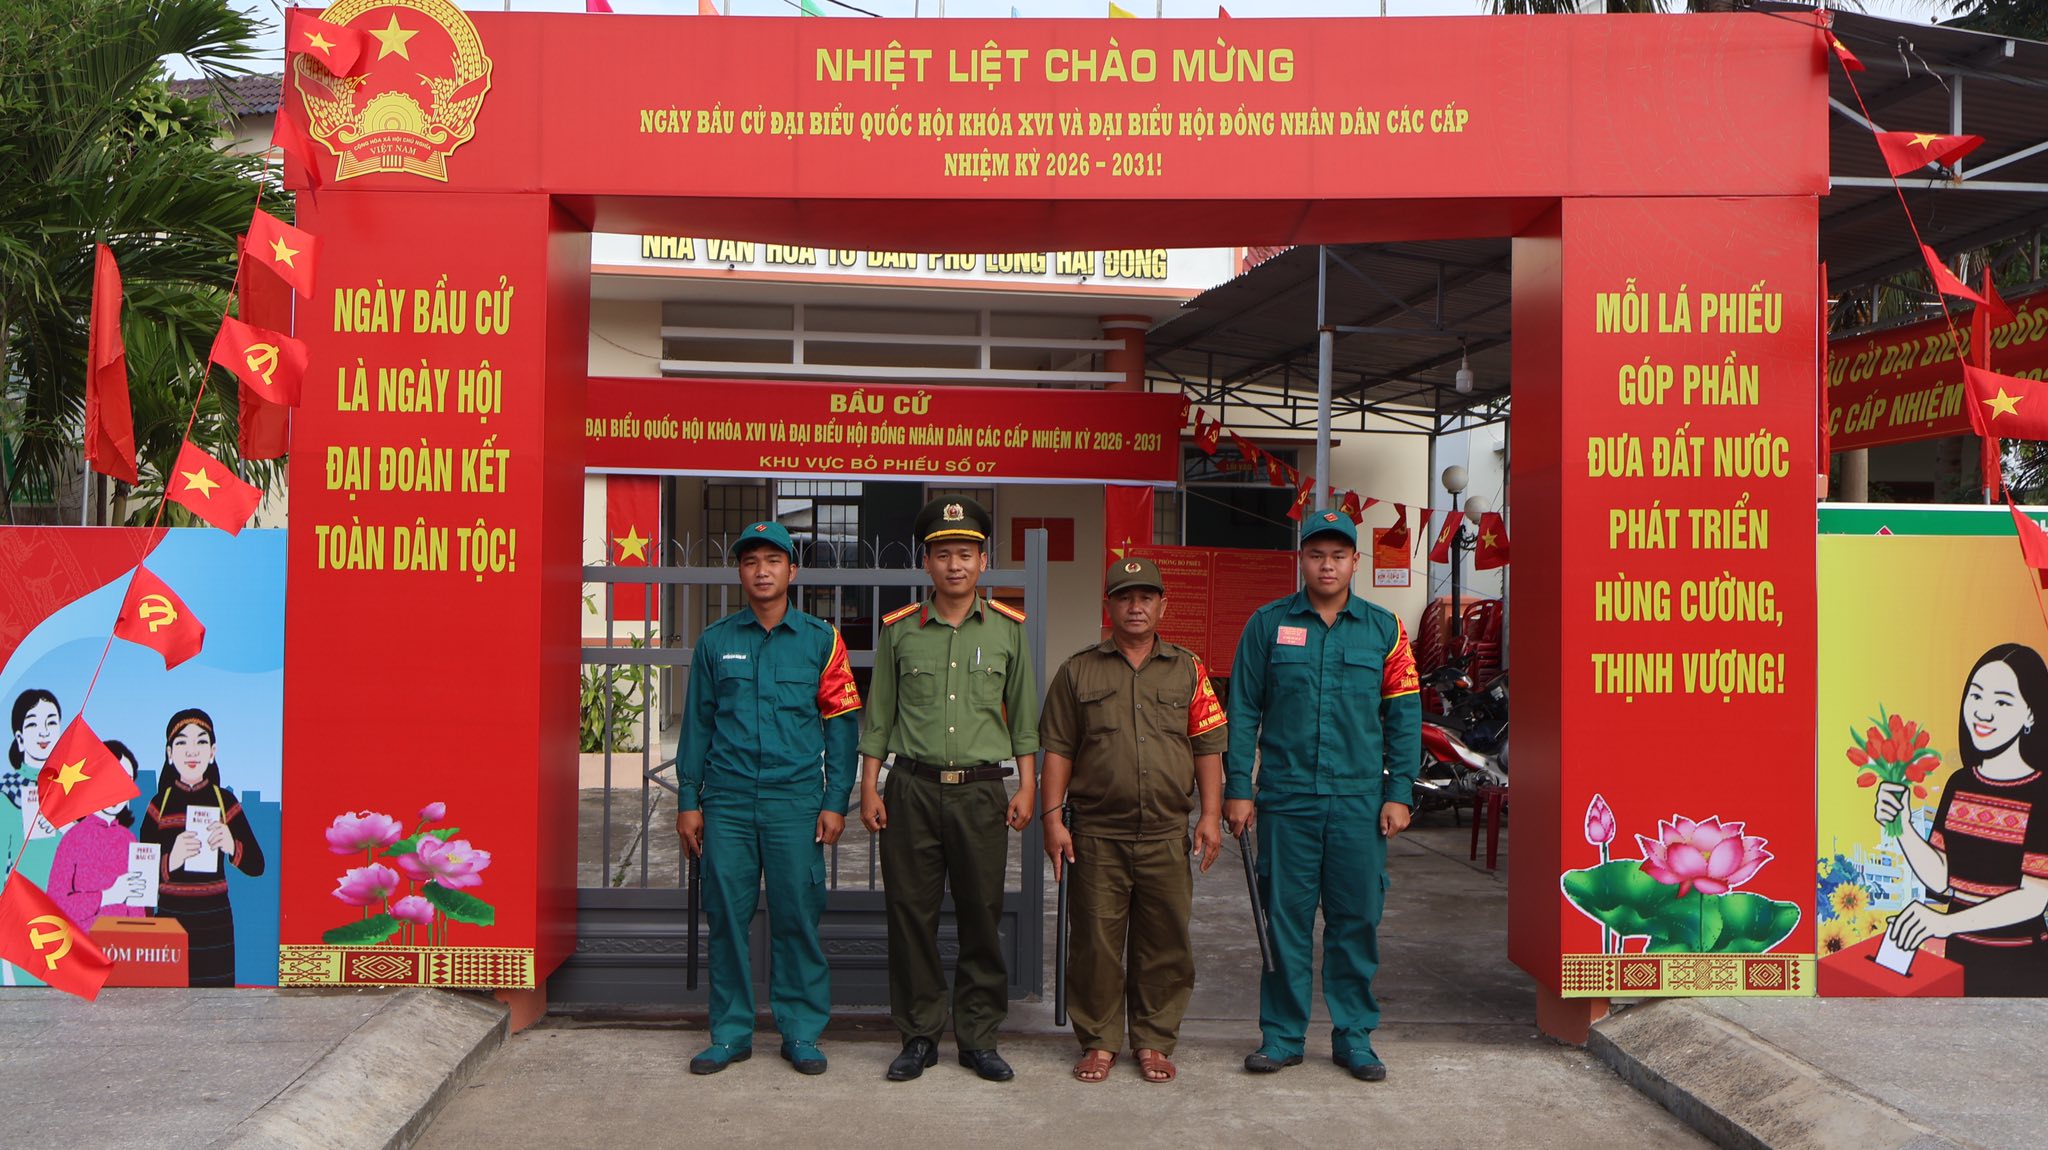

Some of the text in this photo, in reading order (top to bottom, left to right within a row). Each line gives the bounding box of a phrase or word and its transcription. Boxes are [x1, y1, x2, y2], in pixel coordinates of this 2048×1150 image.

[816, 37, 1294, 91] NHIỆT LIỆT CHÀO MỪNG
[370, 143, 417, 155] VIỆT NAM
[640, 103, 1469, 142] NGÀY BẦU CỬ ĐẠI BIỂU QUỐC HỘI KHÓA XVI VÀ ĐẠI BIỂU HỘI ĐỒNG NHÂN DÂN CÁC CẤP
[944, 147, 1010, 182] NHIỆM
[1015, 147, 1041, 176] KỲ
[1046, 152, 1091, 176] 2026
[1112, 152, 1163, 176] 2031!
[333, 274, 515, 336] NGÀY BẦU CỬ
[1596, 277, 1783, 334] MỖI LÁ PHIẾU
[337, 357, 503, 424] LÀ NGÀY HỘI
[1619, 351, 1760, 406] GÓP PHẦN
[1828, 350, 1849, 387] ẦU
[831, 389, 932, 415] BẦU CỬ
[1844, 389, 1887, 434] CẤP
[1889, 380, 1965, 427] NHIỆM
[585, 417, 607, 441] ĐẠI
[610, 411, 640, 439] BIỂU
[643, 413, 679, 441] QUỐC
[682, 417, 704, 444] HỘI
[707, 419, 742, 441] KHÓA
[745, 422, 765, 442] XVI
[770, 420, 785, 442] VÀ
[789, 423, 811, 446] ĐẠI
[814, 417, 842, 444] BIỂU
[846, 421, 867, 448] HỘI
[871, 420, 905, 445] ĐỒNG
[909, 423, 943, 446] NHÂN
[947, 425, 973, 447] DÂN
[976, 425, 1000, 448] CÁC
[1004, 422, 1029, 448] CẤP
[1032, 427, 1071, 453] NHIỆM
[1075, 428, 1090, 449] KỲ
[1093, 432, 1122, 451] 2026
[1134, 433, 1162, 451] 2031
[1588, 420, 1790, 478] ĐƯA ĐẤT NƯỚC
[326, 434, 511, 502] ĐẠI ĐOÀN KẾT
[760, 454, 996, 472] KHU VỰC BỎ PHIẾU SỐ 07
[1609, 491, 1769, 550] PHÁT TRIỂN
[314, 515, 517, 583] TOÀN DÂN TỘC!
[1595, 570, 1784, 627] HÙNG CƯỜNG,
[1591, 648, 1786, 704] THỊNH VƯỢNG!
